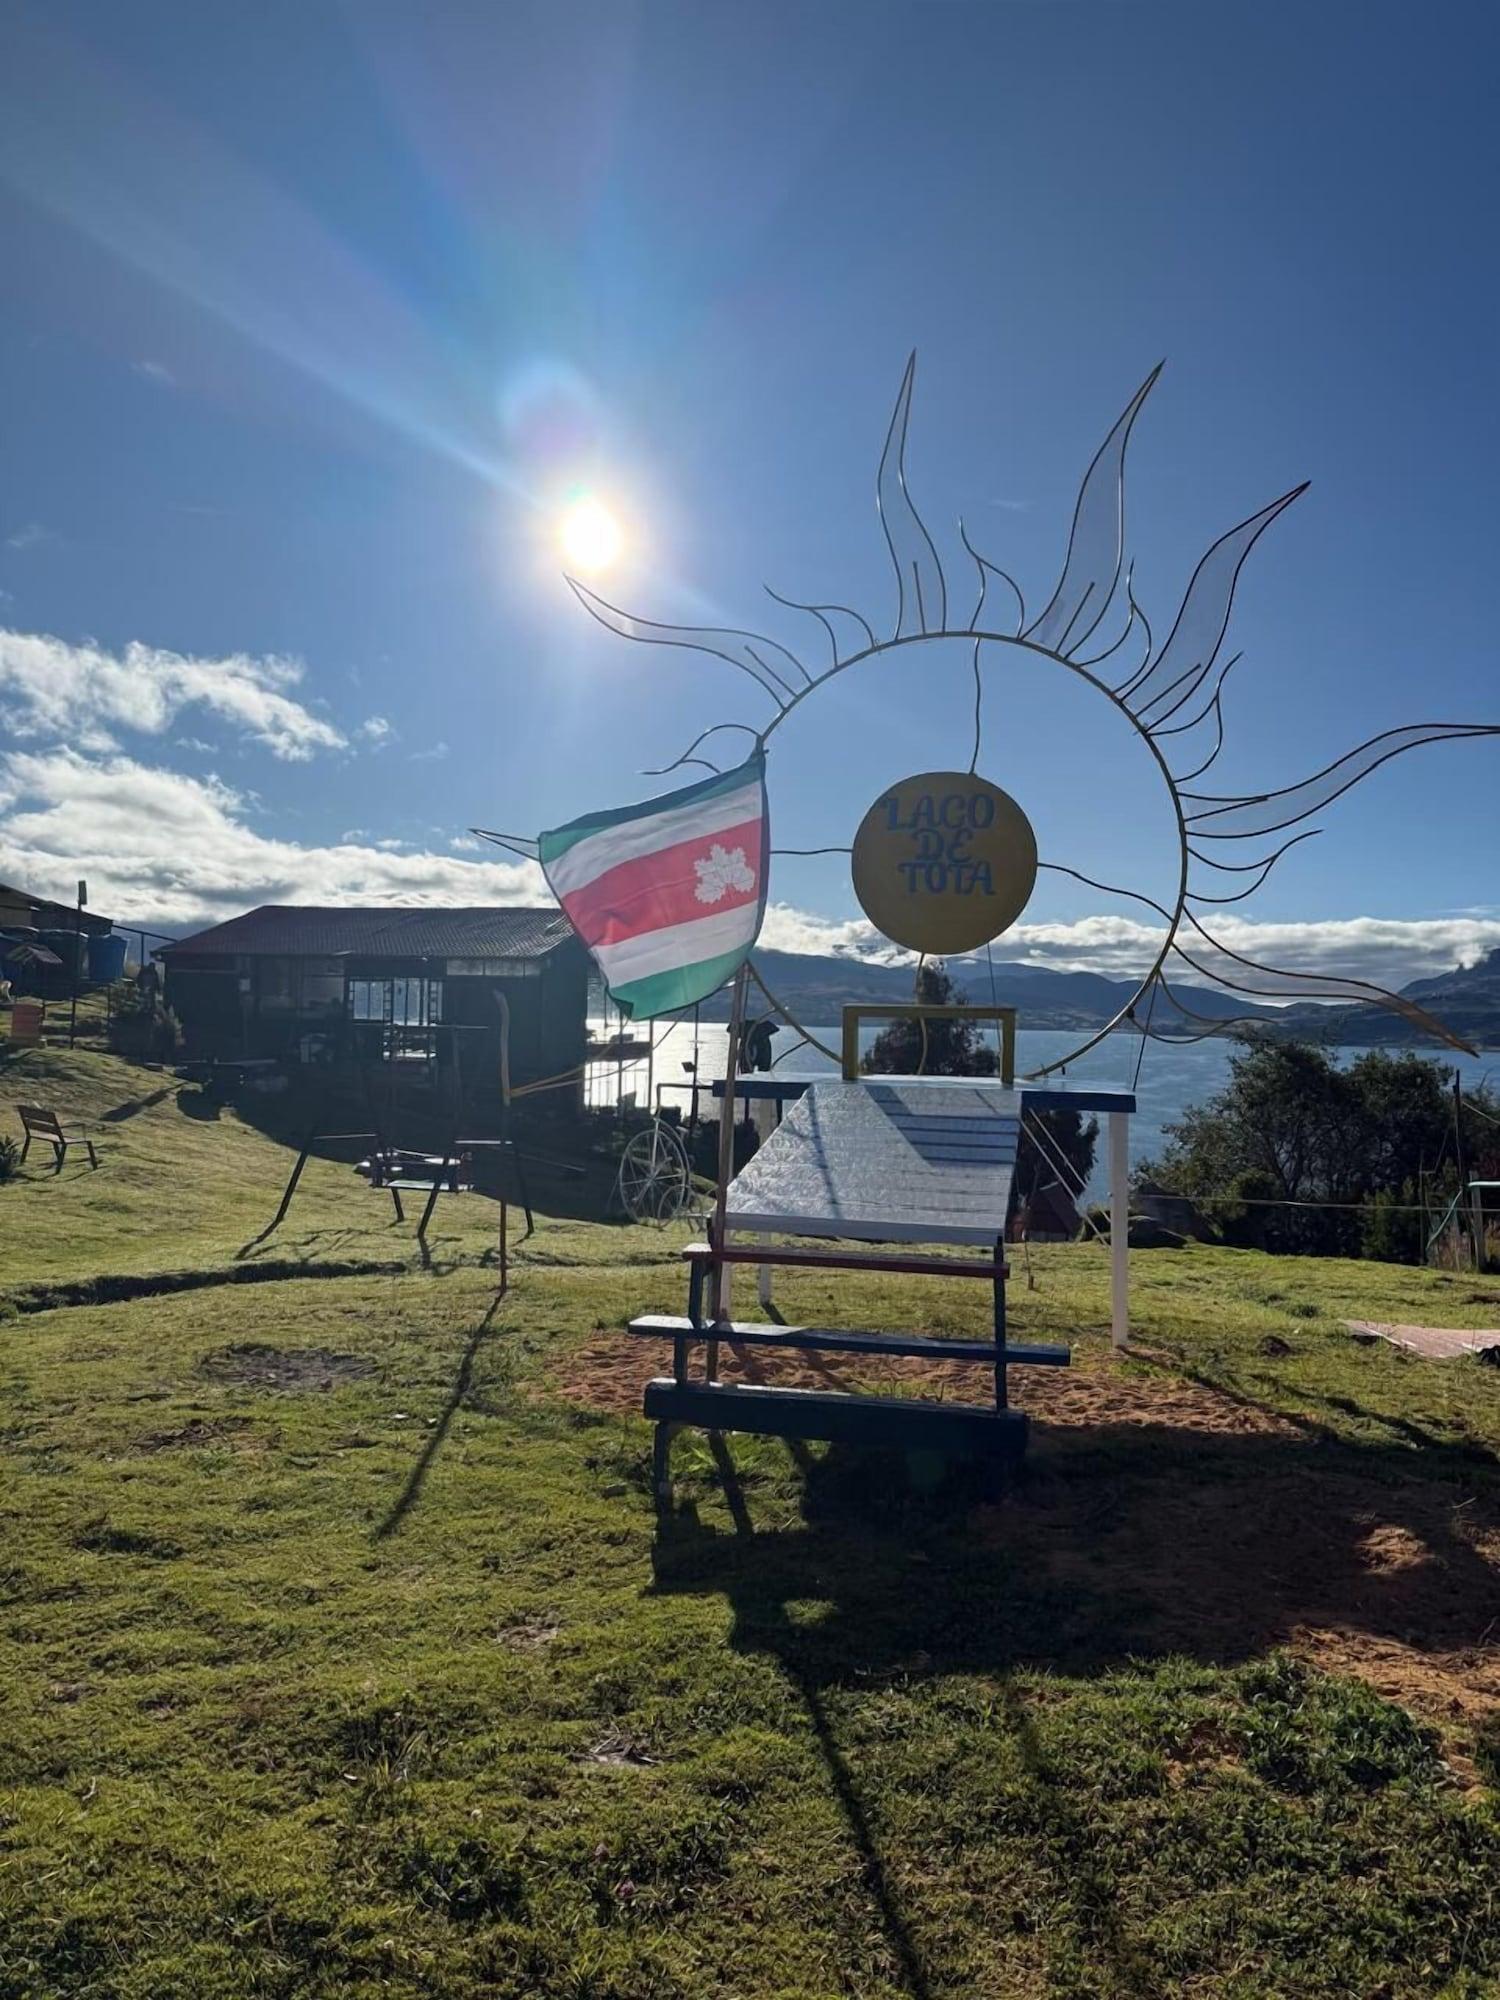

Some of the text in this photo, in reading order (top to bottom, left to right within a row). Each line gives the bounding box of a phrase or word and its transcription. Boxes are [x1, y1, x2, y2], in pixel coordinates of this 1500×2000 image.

[881, 794, 995, 830] LAGO
[912, 828, 974, 862] DE
[898, 861, 996, 895] TOTA
